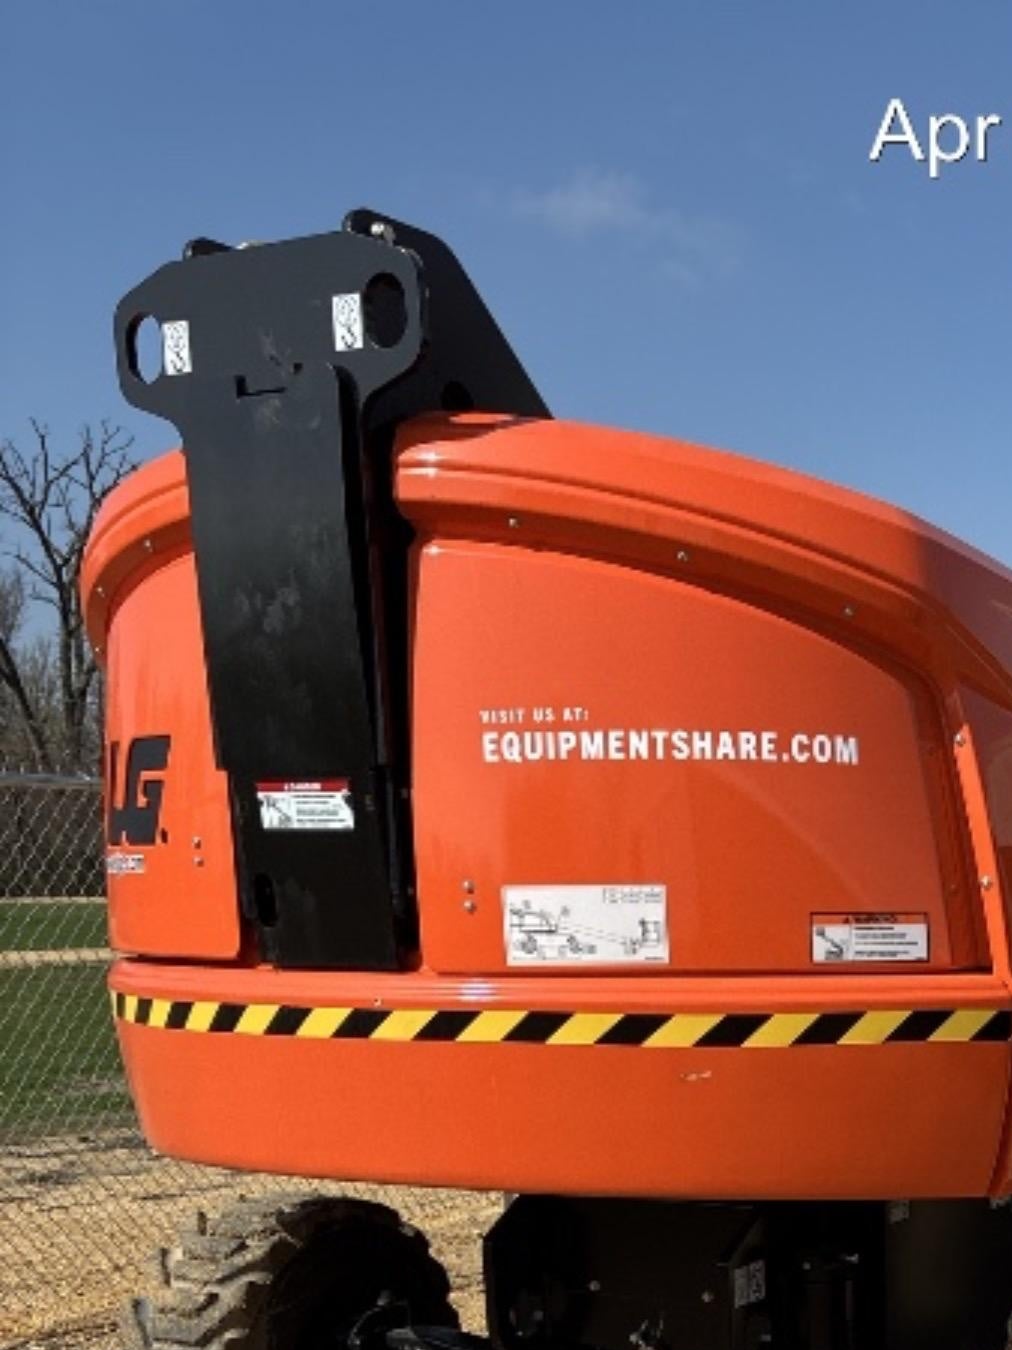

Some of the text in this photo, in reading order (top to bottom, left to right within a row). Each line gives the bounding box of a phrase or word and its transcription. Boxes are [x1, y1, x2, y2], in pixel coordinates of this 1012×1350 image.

[479, 706, 589, 724] VISIT US AT:
[482, 728, 859, 765] EQUIPMENTSHARE.COM
[107, 734, 171, 846] LG
